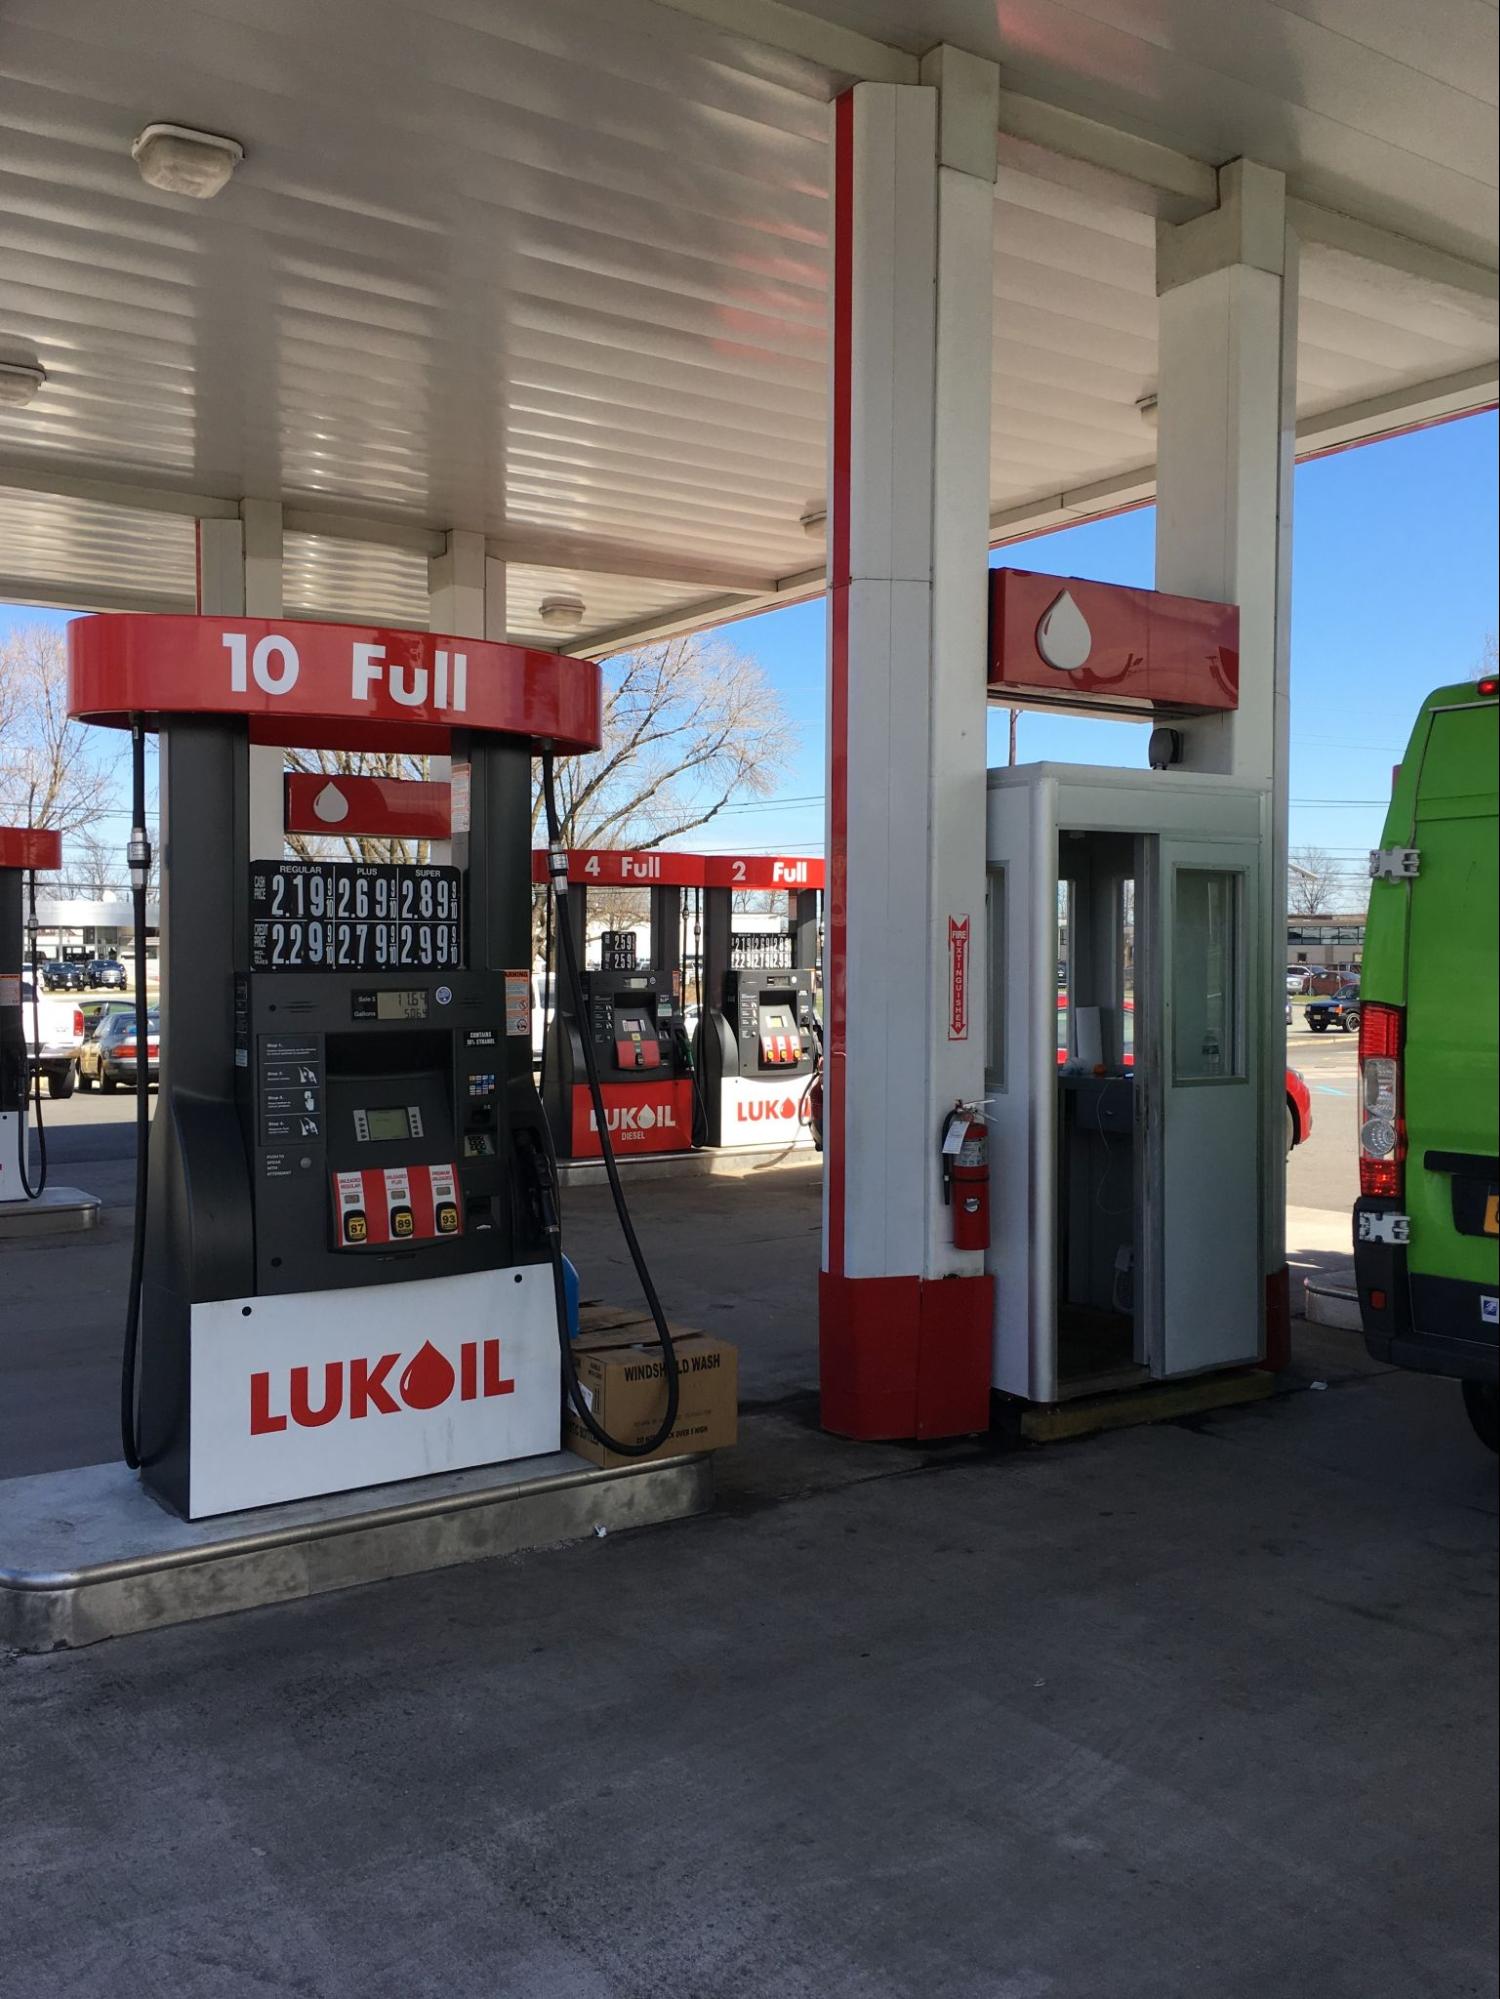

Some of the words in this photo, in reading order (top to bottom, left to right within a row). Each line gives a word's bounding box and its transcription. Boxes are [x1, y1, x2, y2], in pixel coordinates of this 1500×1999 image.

[222, 632, 299, 695] 10
[352, 642, 467, 712] Full
[357, 868, 378, 876] PLUS
[584, 856, 600, 876] 4
[621, 857, 660, 878] Full
[731, 861, 746, 881] 2
[772, 862, 807, 882] Full
[272, 875, 324, 917] 2.19
[338, 878, 387, 918] 2.69
[402, 879, 448, 919] 2.89
[272, 922, 323, 964] 2.29
[338, 924, 387, 964] 2.79
[401, 924, 448, 964] 2.99
[952, 930, 967, 939] FIRE
[954, 940, 963, 1028] EXTINGUISHER
[621, 1131, 646, 1141] DIESEL
[350, 1223, 365, 1234] 87
[397, 1218, 411, 1229] 89
[442, 1215, 456, 1225] 93
[624, 1359, 690, 1383] WINDSHLD
[692, 1353, 721, 1373] WASH
[250, 1338, 515, 1436] LUKOIL
